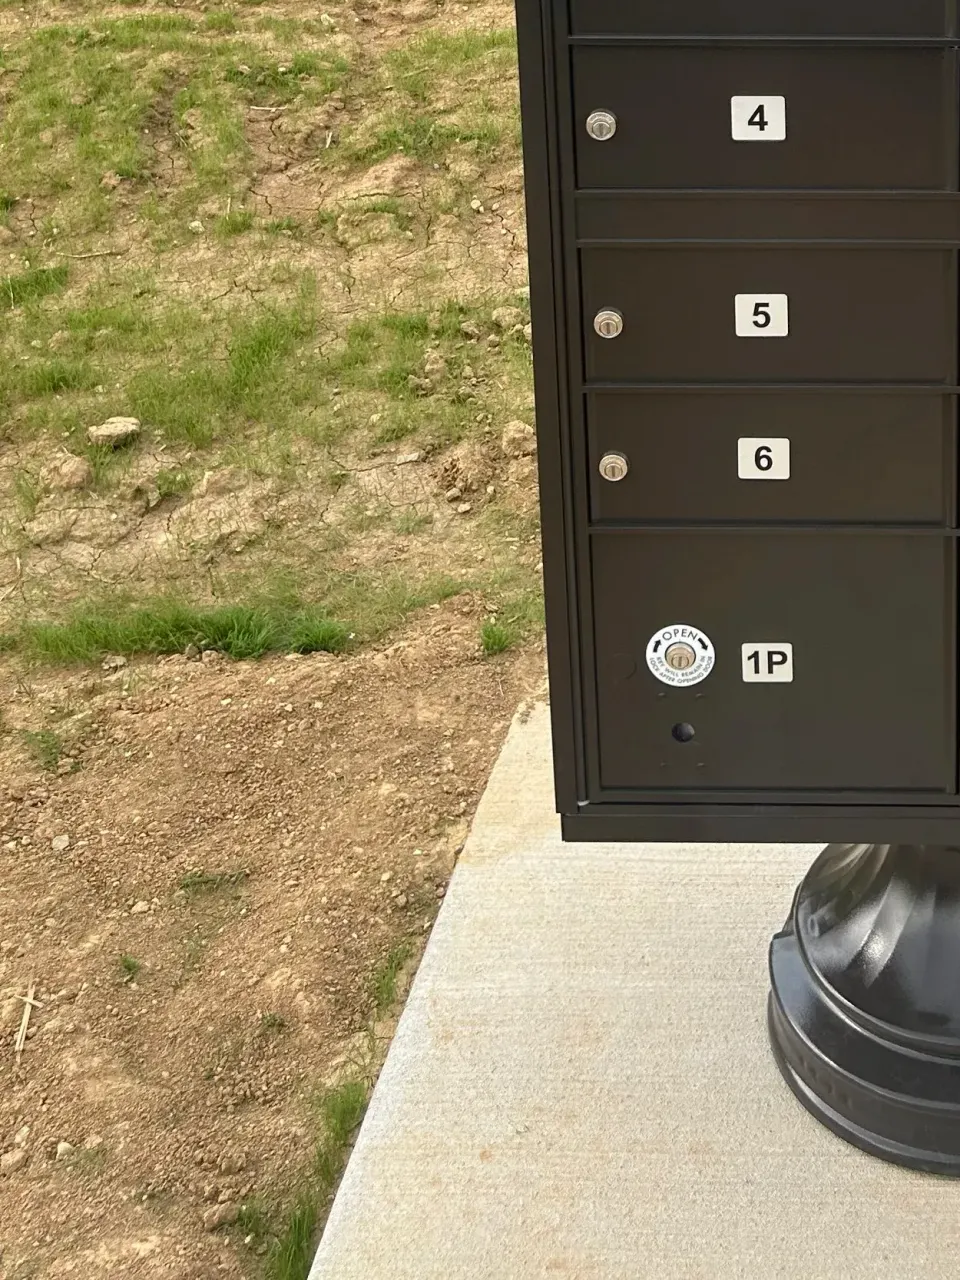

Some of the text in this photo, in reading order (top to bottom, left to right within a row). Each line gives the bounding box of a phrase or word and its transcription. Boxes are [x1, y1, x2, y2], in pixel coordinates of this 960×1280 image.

[748, 105, 768, 131] 4
[753, 303, 770, 328] 5
[755, 446, 772, 471] 6
[662, 628, 698, 640] OPEN
[650, 656, 712, 684] LOCK AFTER OPENING DOOR
[665, 668, 679, 677] WILL
[682, 664, 703, 677] REMAIN
[748, 651, 787, 674] 1P
